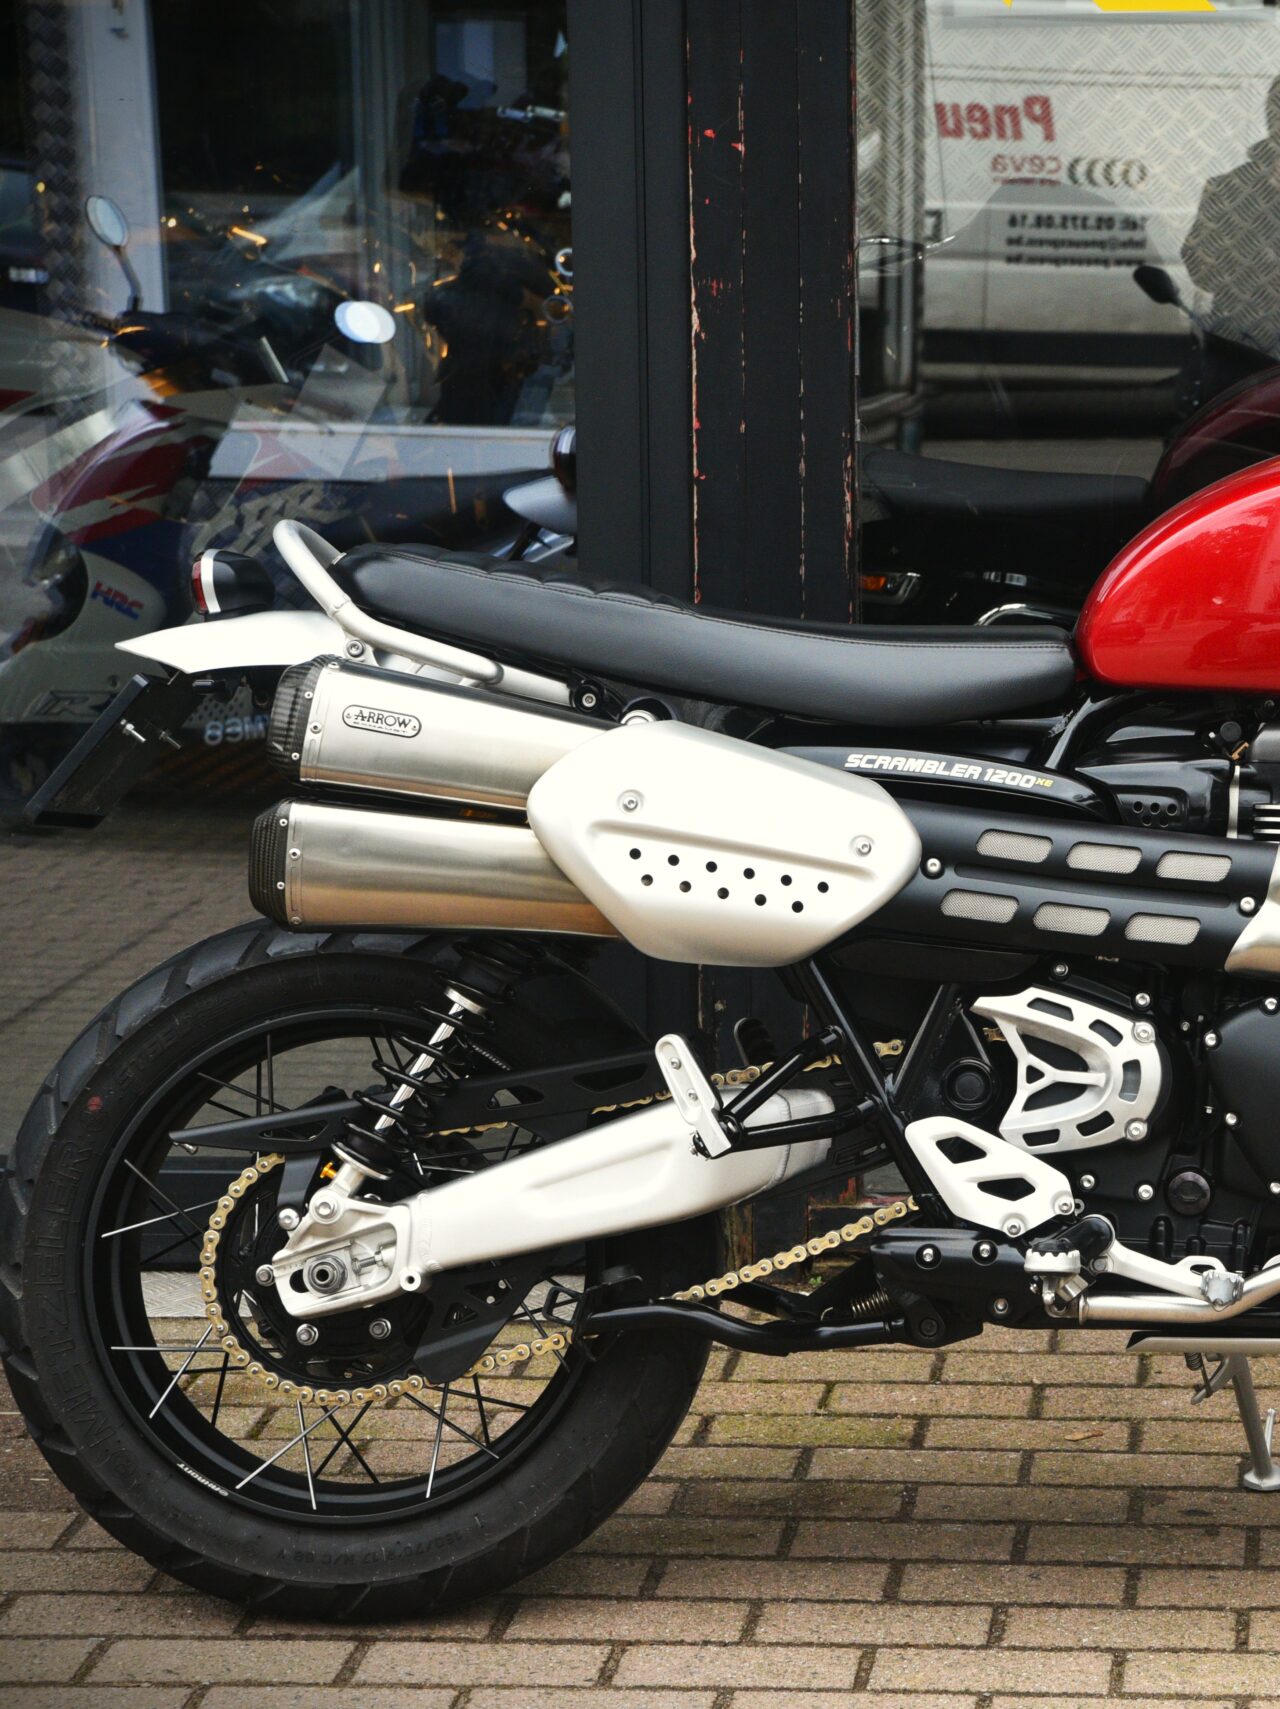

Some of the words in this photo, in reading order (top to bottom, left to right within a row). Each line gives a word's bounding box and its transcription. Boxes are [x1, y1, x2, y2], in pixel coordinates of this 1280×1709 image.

[90, 580, 145, 621] HRC
[353, 709, 412, 729] ARROW
[844, 753, 982, 781] SCRAMBLER
[983, 768, 1037, 789] 1200
[1035, 777, 1054, 788] XE
[32, 1138, 117, 1449] METZELER
